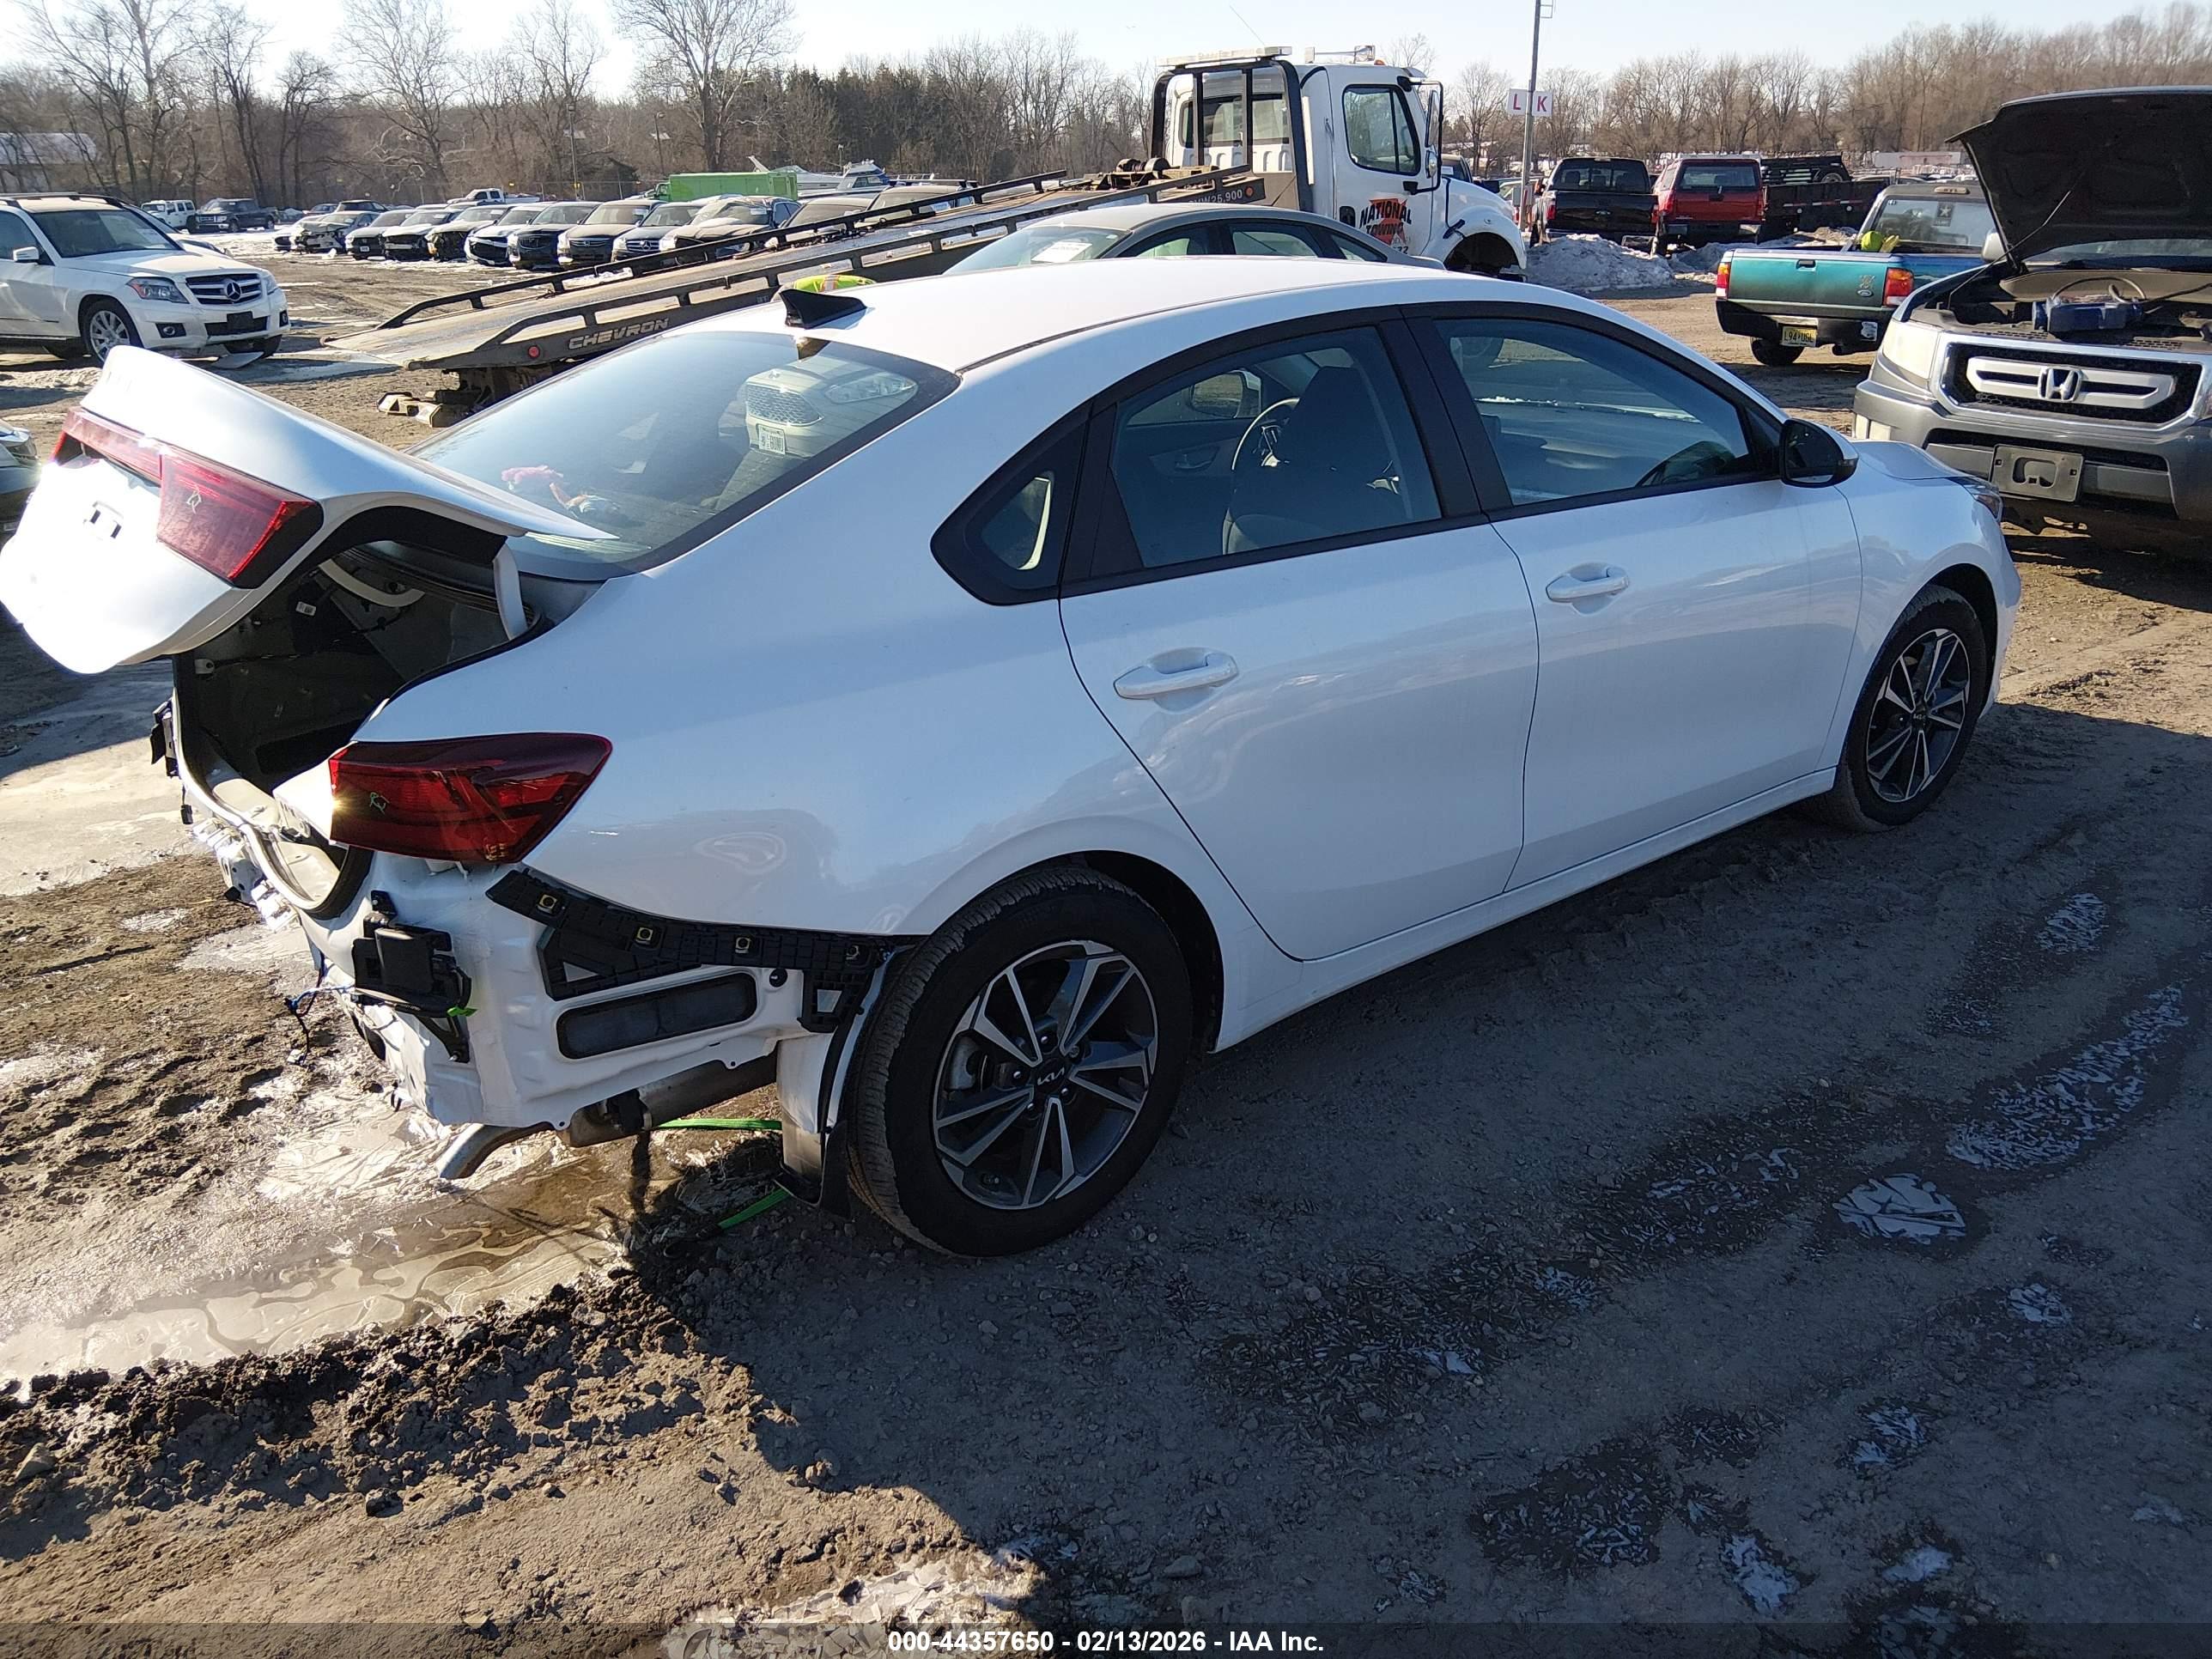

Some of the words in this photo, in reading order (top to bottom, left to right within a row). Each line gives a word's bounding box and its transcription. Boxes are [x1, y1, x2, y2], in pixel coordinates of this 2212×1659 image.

[1512, 93, 1522, 111] L
[1536, 95, 1548, 112] K
[1359, 200, 1413, 228] NATIONAL
[568, 318, 670, 350] CHEVRON
